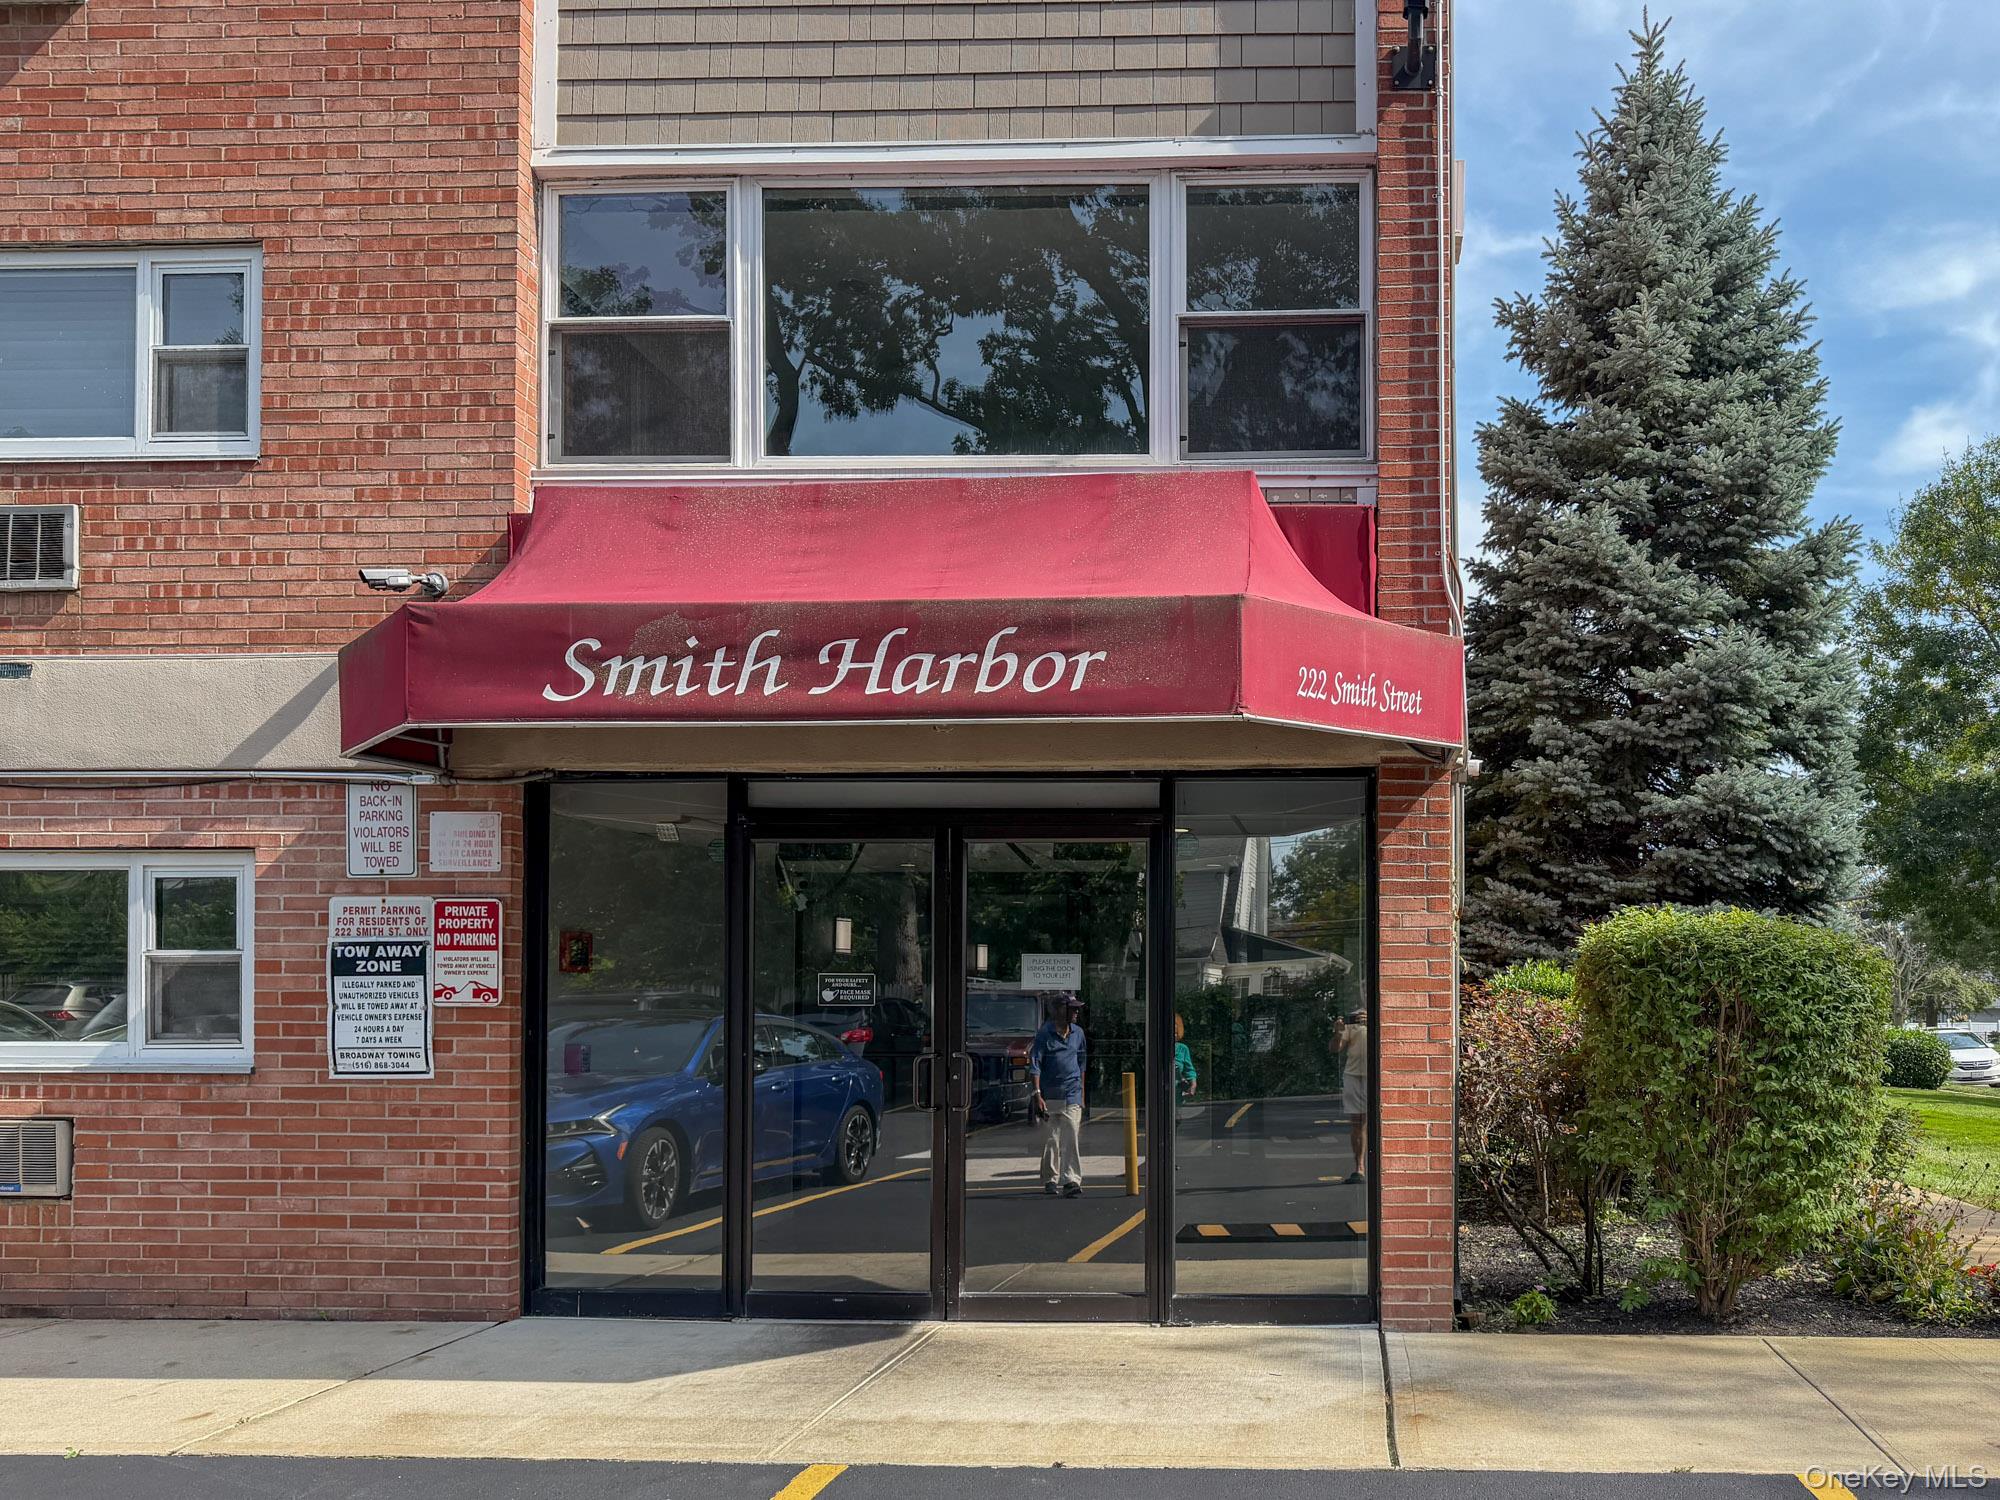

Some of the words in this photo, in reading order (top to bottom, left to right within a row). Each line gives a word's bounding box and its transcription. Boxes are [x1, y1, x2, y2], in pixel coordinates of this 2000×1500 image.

[542, 628, 788, 702] Smith
[808, 627, 1108, 696] Harbor
[1296, 666, 1328, 700] 222
[1330, 671, 1377, 708] Smith
[1379, 679, 1423, 715] Street
[370, 780, 391, 792] NO
[359, 795, 402, 807] BACK-IN
[359, 810, 403, 821] PARKING
[353, 826, 410, 838] VIOLATORS
[360, 841, 385, 853] WILL
[389, 841, 402, 853] BE
[364, 856, 399, 867] TOWED
[343, 906, 377, 915] PERMIT
[381, 906, 421, 915] PARKING
[444, 906, 488, 917] PRIVATE
[337, 917, 355, 926] FOR
[359, 917, 410, 926] RESIDENTS
[414, 917, 427, 926] OF
[438, 918, 494, 929] PROPERTY
[335, 927, 352, 936] 222
[356, 927, 384, 936] SMITH
[388, 927, 402, 936] ST.
[406, 927, 428, 936] ONLY
[436, 933, 450, 946] NO
[453, 933, 496, 946] PARKING
[334, 945, 370, 958] TOW
[375, 945, 423, 957] AWAY
[355, 960, 402, 972] ZONE
[341, 1002, 355, 1010] WILL
[357, 1002, 365, 1010] BE
[367, 1002, 389, 1010] TOWED
[390, 1002, 408, 1010] AWAY
[410, 1002, 417, 1010] AT
[385, 1036, 402, 1044] WEEK
[352, 1061, 372, 1069] (516)
[374, 1061, 410, 1069] 868-3044
